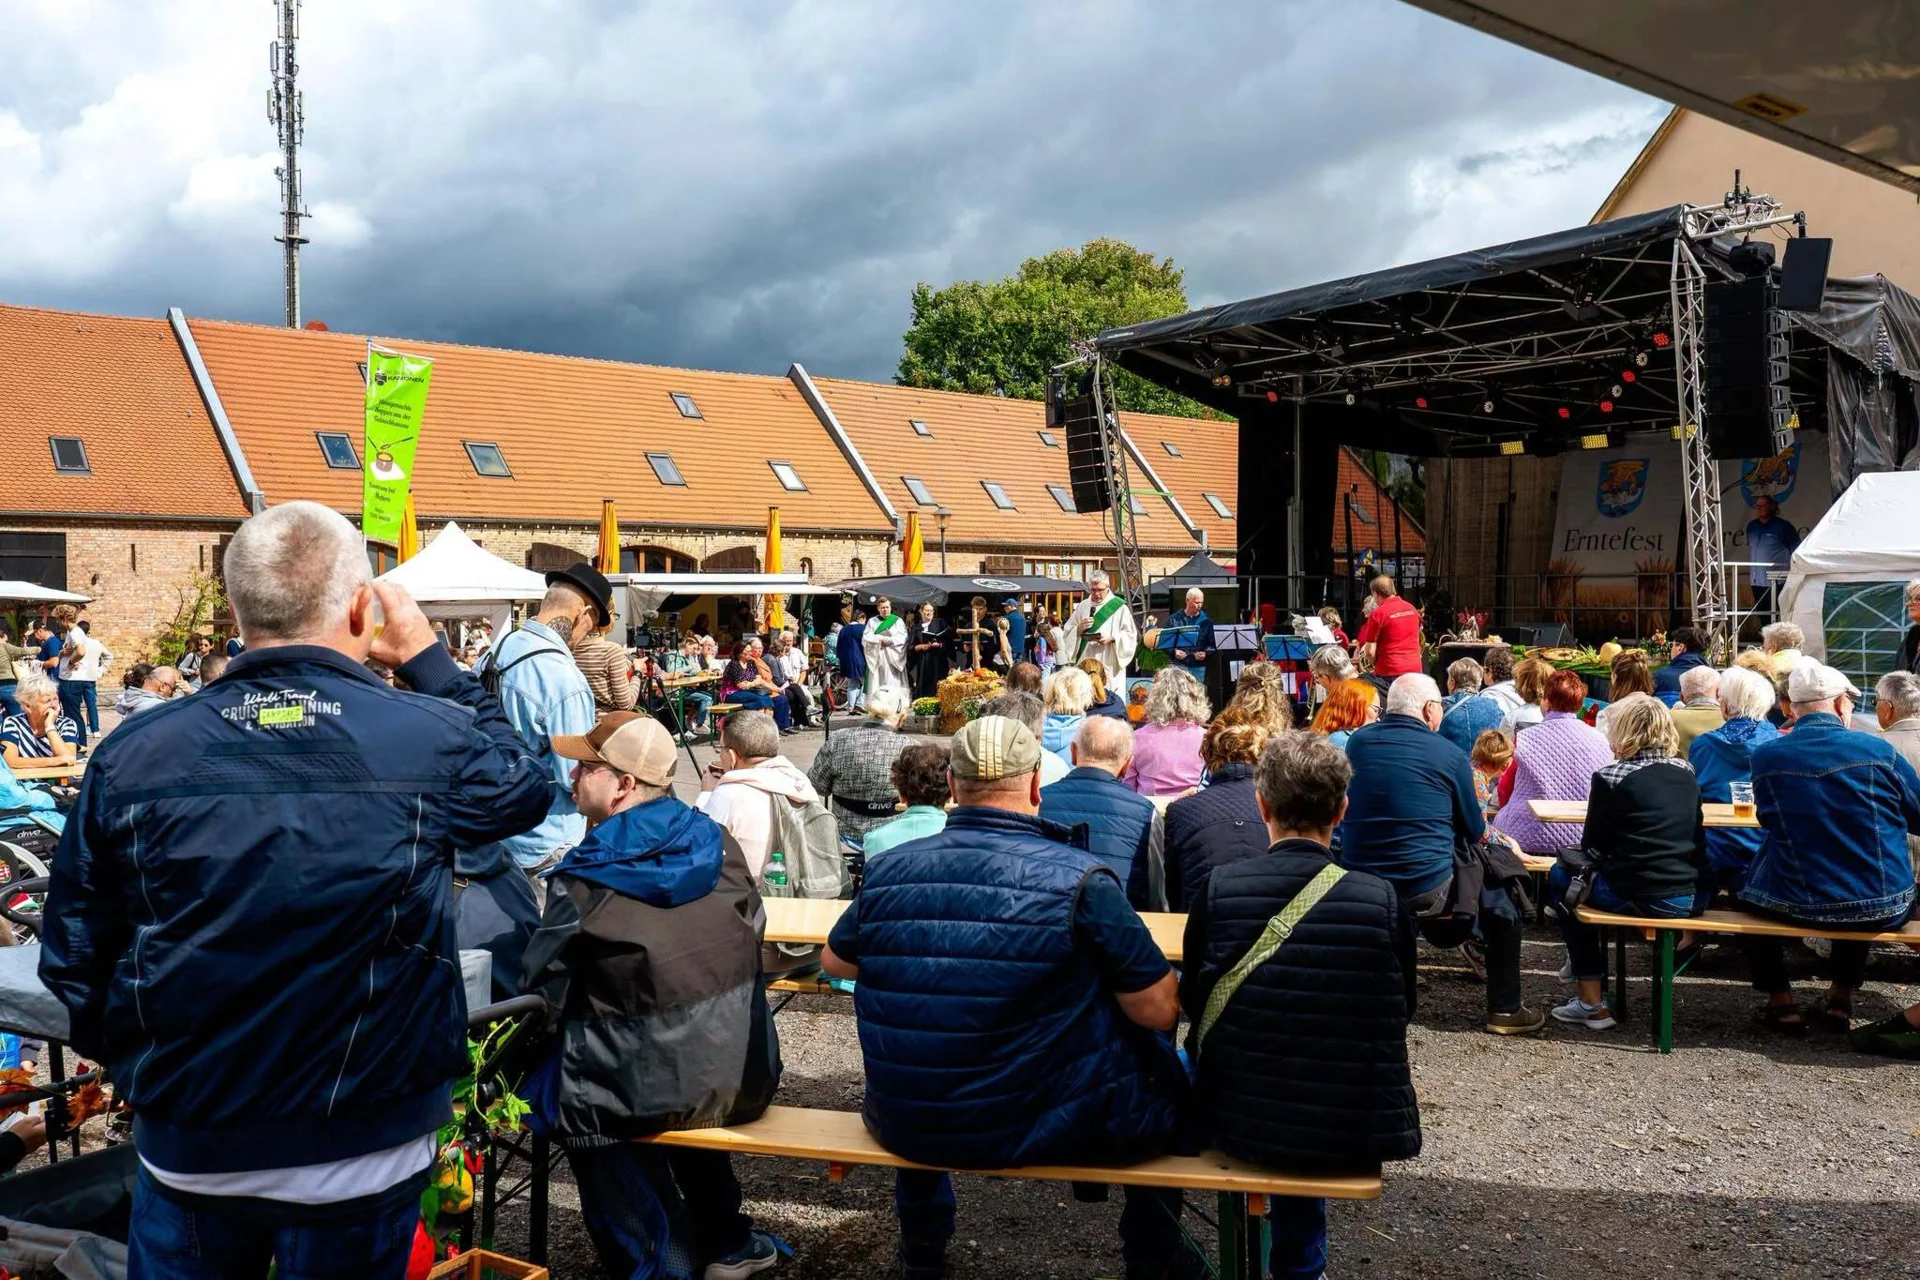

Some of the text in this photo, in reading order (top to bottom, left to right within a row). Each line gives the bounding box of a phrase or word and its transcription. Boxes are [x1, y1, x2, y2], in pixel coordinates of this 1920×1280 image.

[1563, 526, 1663, 551] Erntefest
[244, 689, 317, 705] World Travel
[245, 720, 253, 730] &
[868, 801, 893, 810] drive
[17, 829, 41, 839] drive
